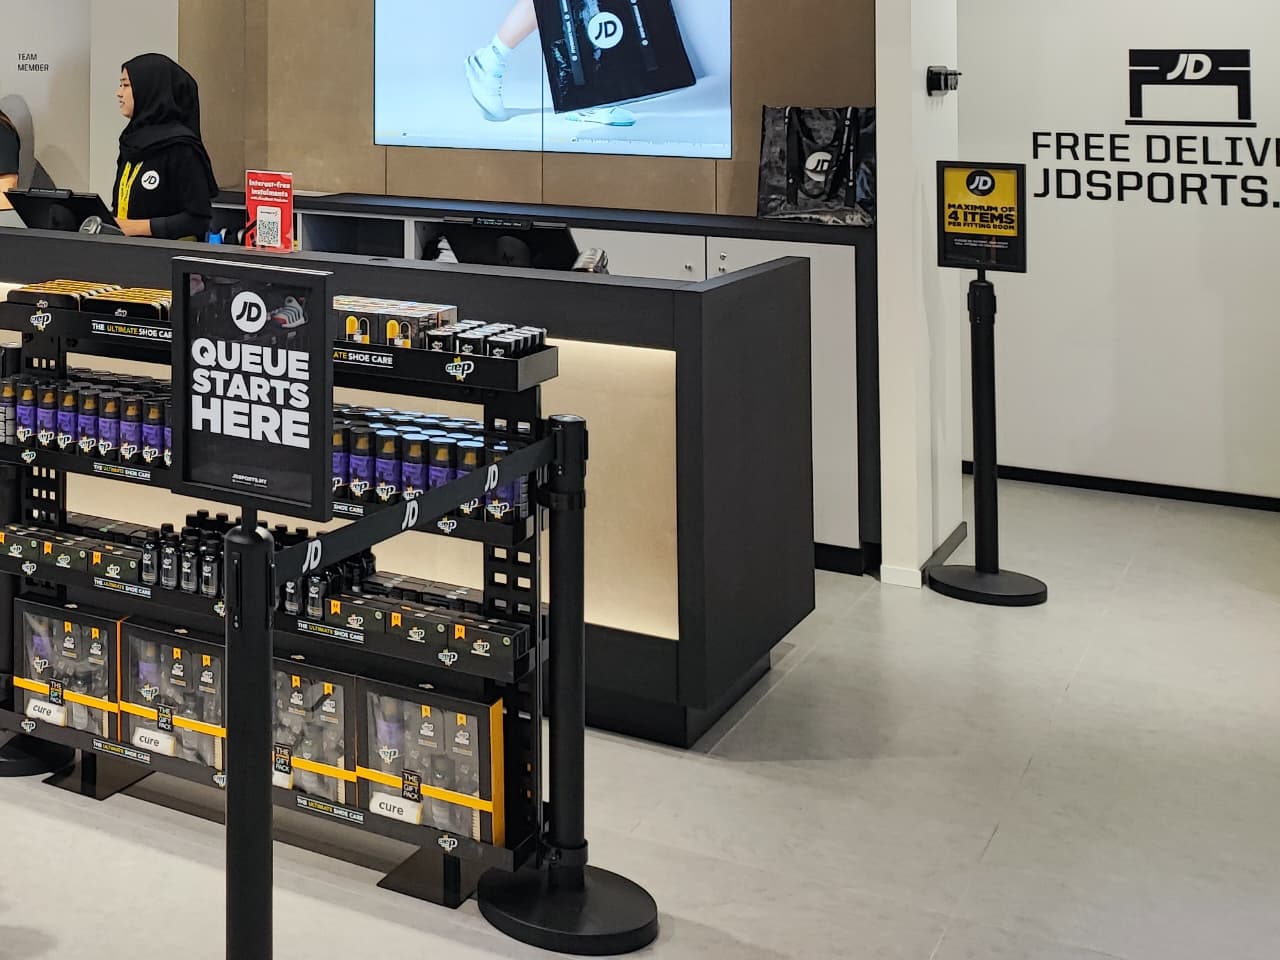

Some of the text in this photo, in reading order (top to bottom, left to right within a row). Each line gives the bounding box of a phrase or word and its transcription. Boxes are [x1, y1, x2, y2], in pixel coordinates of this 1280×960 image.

[17, 53, 38, 61] TEAM
[17, 63, 49, 72] MEMBER
[1166, 52, 1213, 81] JD
[1032, 131, 1280, 167] FREE DELIV
[1032, 168, 1280, 209] JDSPORTS.
[947, 203, 998, 213] MAXIMUM
[947, 210, 1015, 225] 4 ITEMS
[992, 223, 1015, 231] ROOM
[91, 322, 173, 339] THE ULTIMATE SHOE CAR
[191, 337, 310, 381] QUEUE
[348, 352, 370, 363] SHOE
[371, 354, 394, 366] CARE
[445, 361, 475, 378] crep
[192, 367, 310, 410] STARTS
[191, 394, 310, 450] HERE
[484, 464, 499, 493] JD
[401, 500, 419, 531] JD
[302, 539, 322, 574] JD
[94, 578, 103, 586] THE
[138, 588, 152, 596] CARE
[297, 622, 364, 641] THE ULTIMATE SHOE CARE
[32, 704, 52, 716] cure
[139, 735, 160, 747] cure
[137, 752, 151, 761] CARE
[275, 746, 290, 755] THE
[275, 757, 290, 766] GIFT
[275, 763, 290, 773] PACK
[403, 773, 418, 782] THE
[403, 784, 419, 793] GIFT
[403, 791, 419, 800] PACK
[296, 797, 364, 822] THE ULTIMATE SHOE CARE
[378, 801, 404, 816] cure
